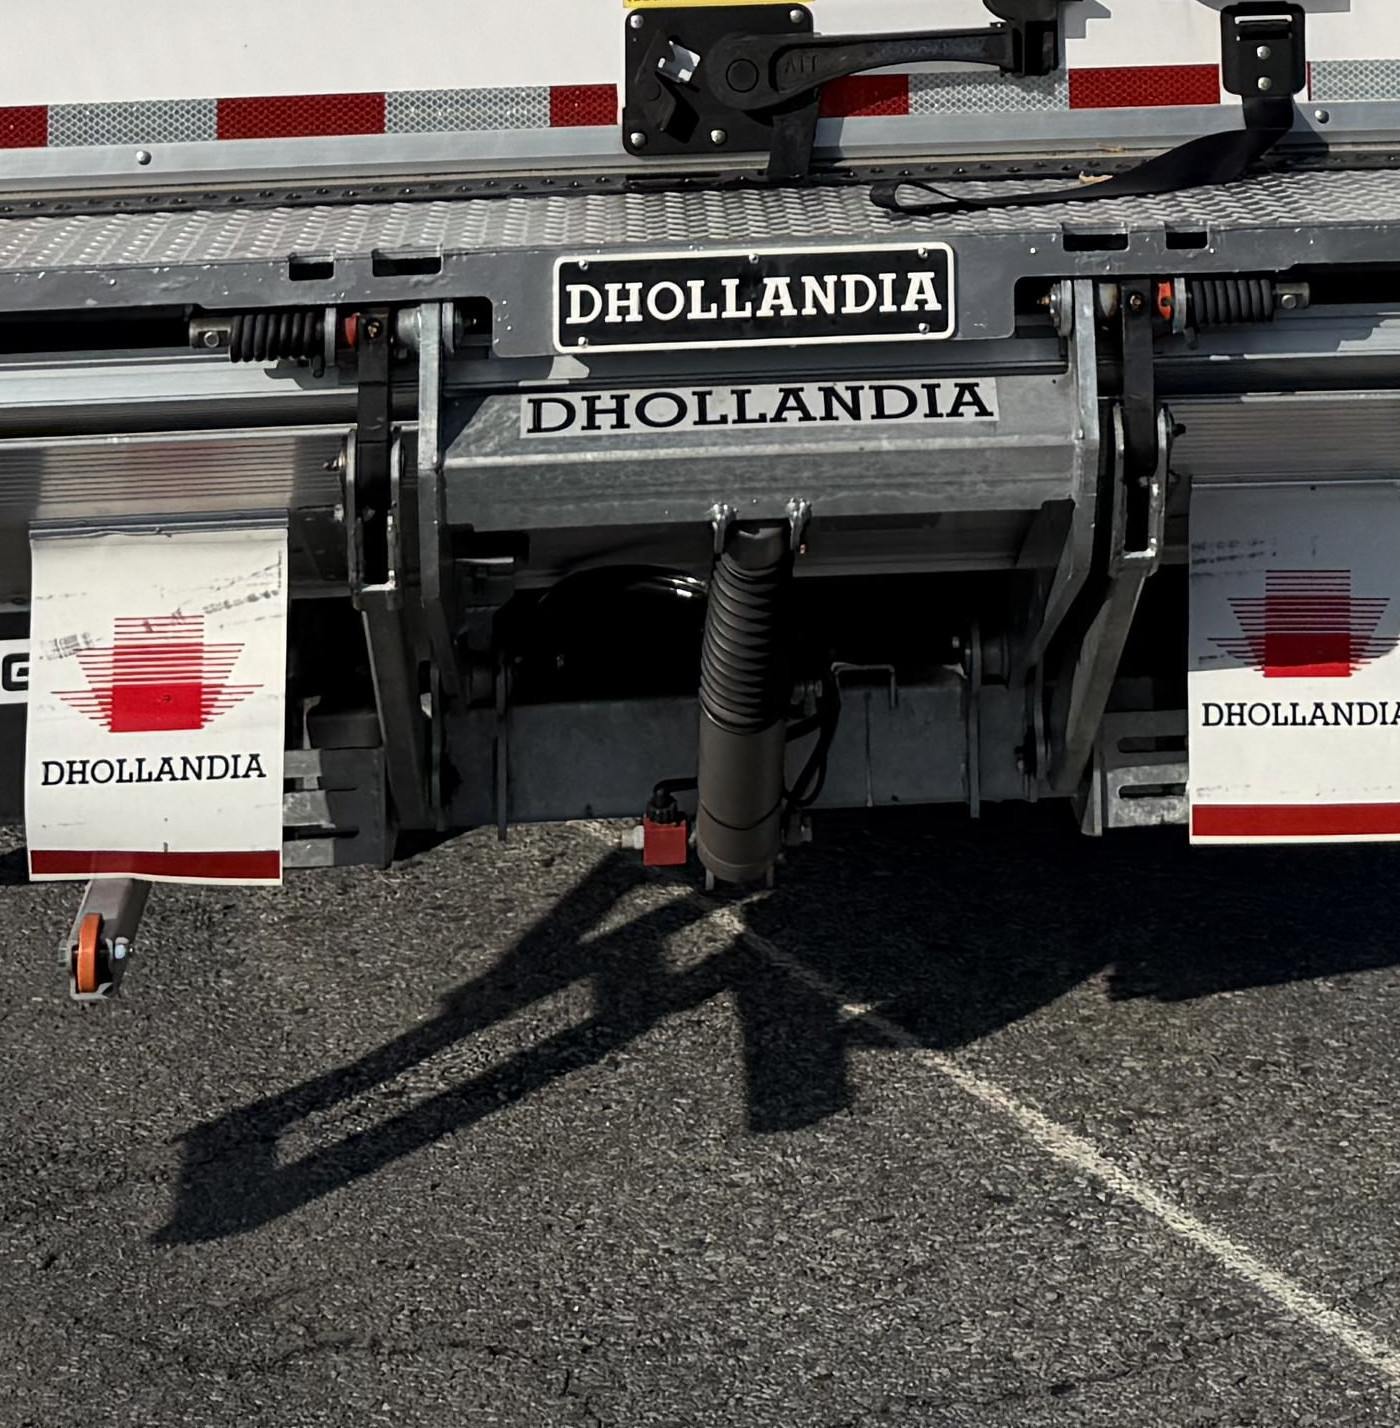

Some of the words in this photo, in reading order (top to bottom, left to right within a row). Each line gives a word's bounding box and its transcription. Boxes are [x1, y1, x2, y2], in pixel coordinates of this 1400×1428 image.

[564, 271, 943, 325] DHOLLANDIA
[527, 381, 994, 434] DHOLLANDIA
[41, 753, 267, 786] DHOLLANDIA
